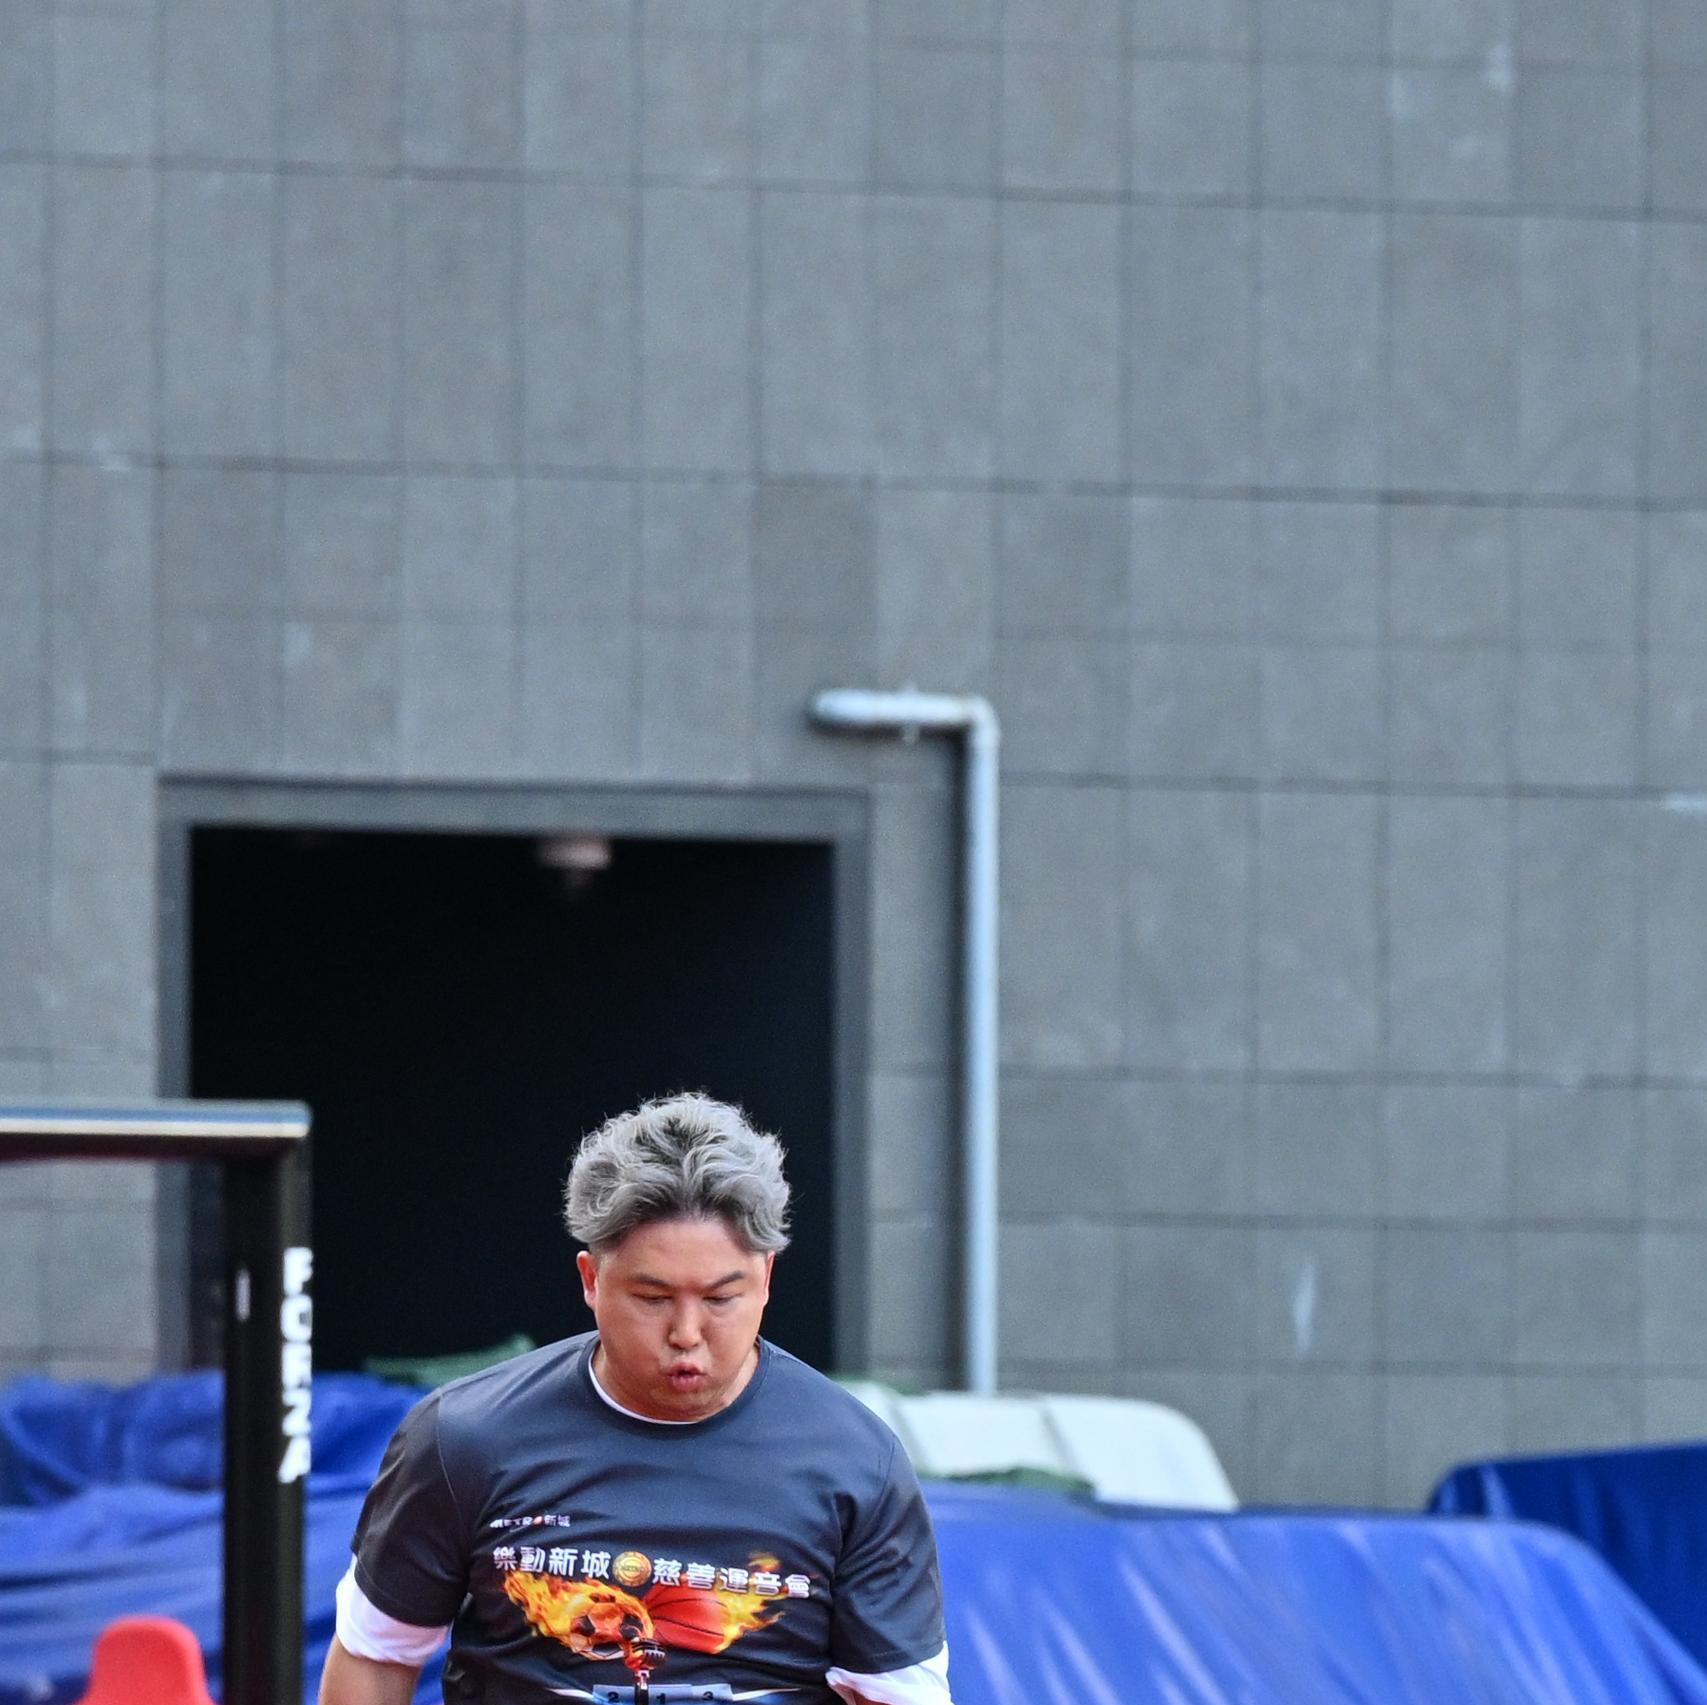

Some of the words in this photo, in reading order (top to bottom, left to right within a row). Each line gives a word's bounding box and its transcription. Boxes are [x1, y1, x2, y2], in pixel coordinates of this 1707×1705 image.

[492, 1546, 611, 1580] 樂動新城
[651, 1557, 812, 1599] 慈善運音會
